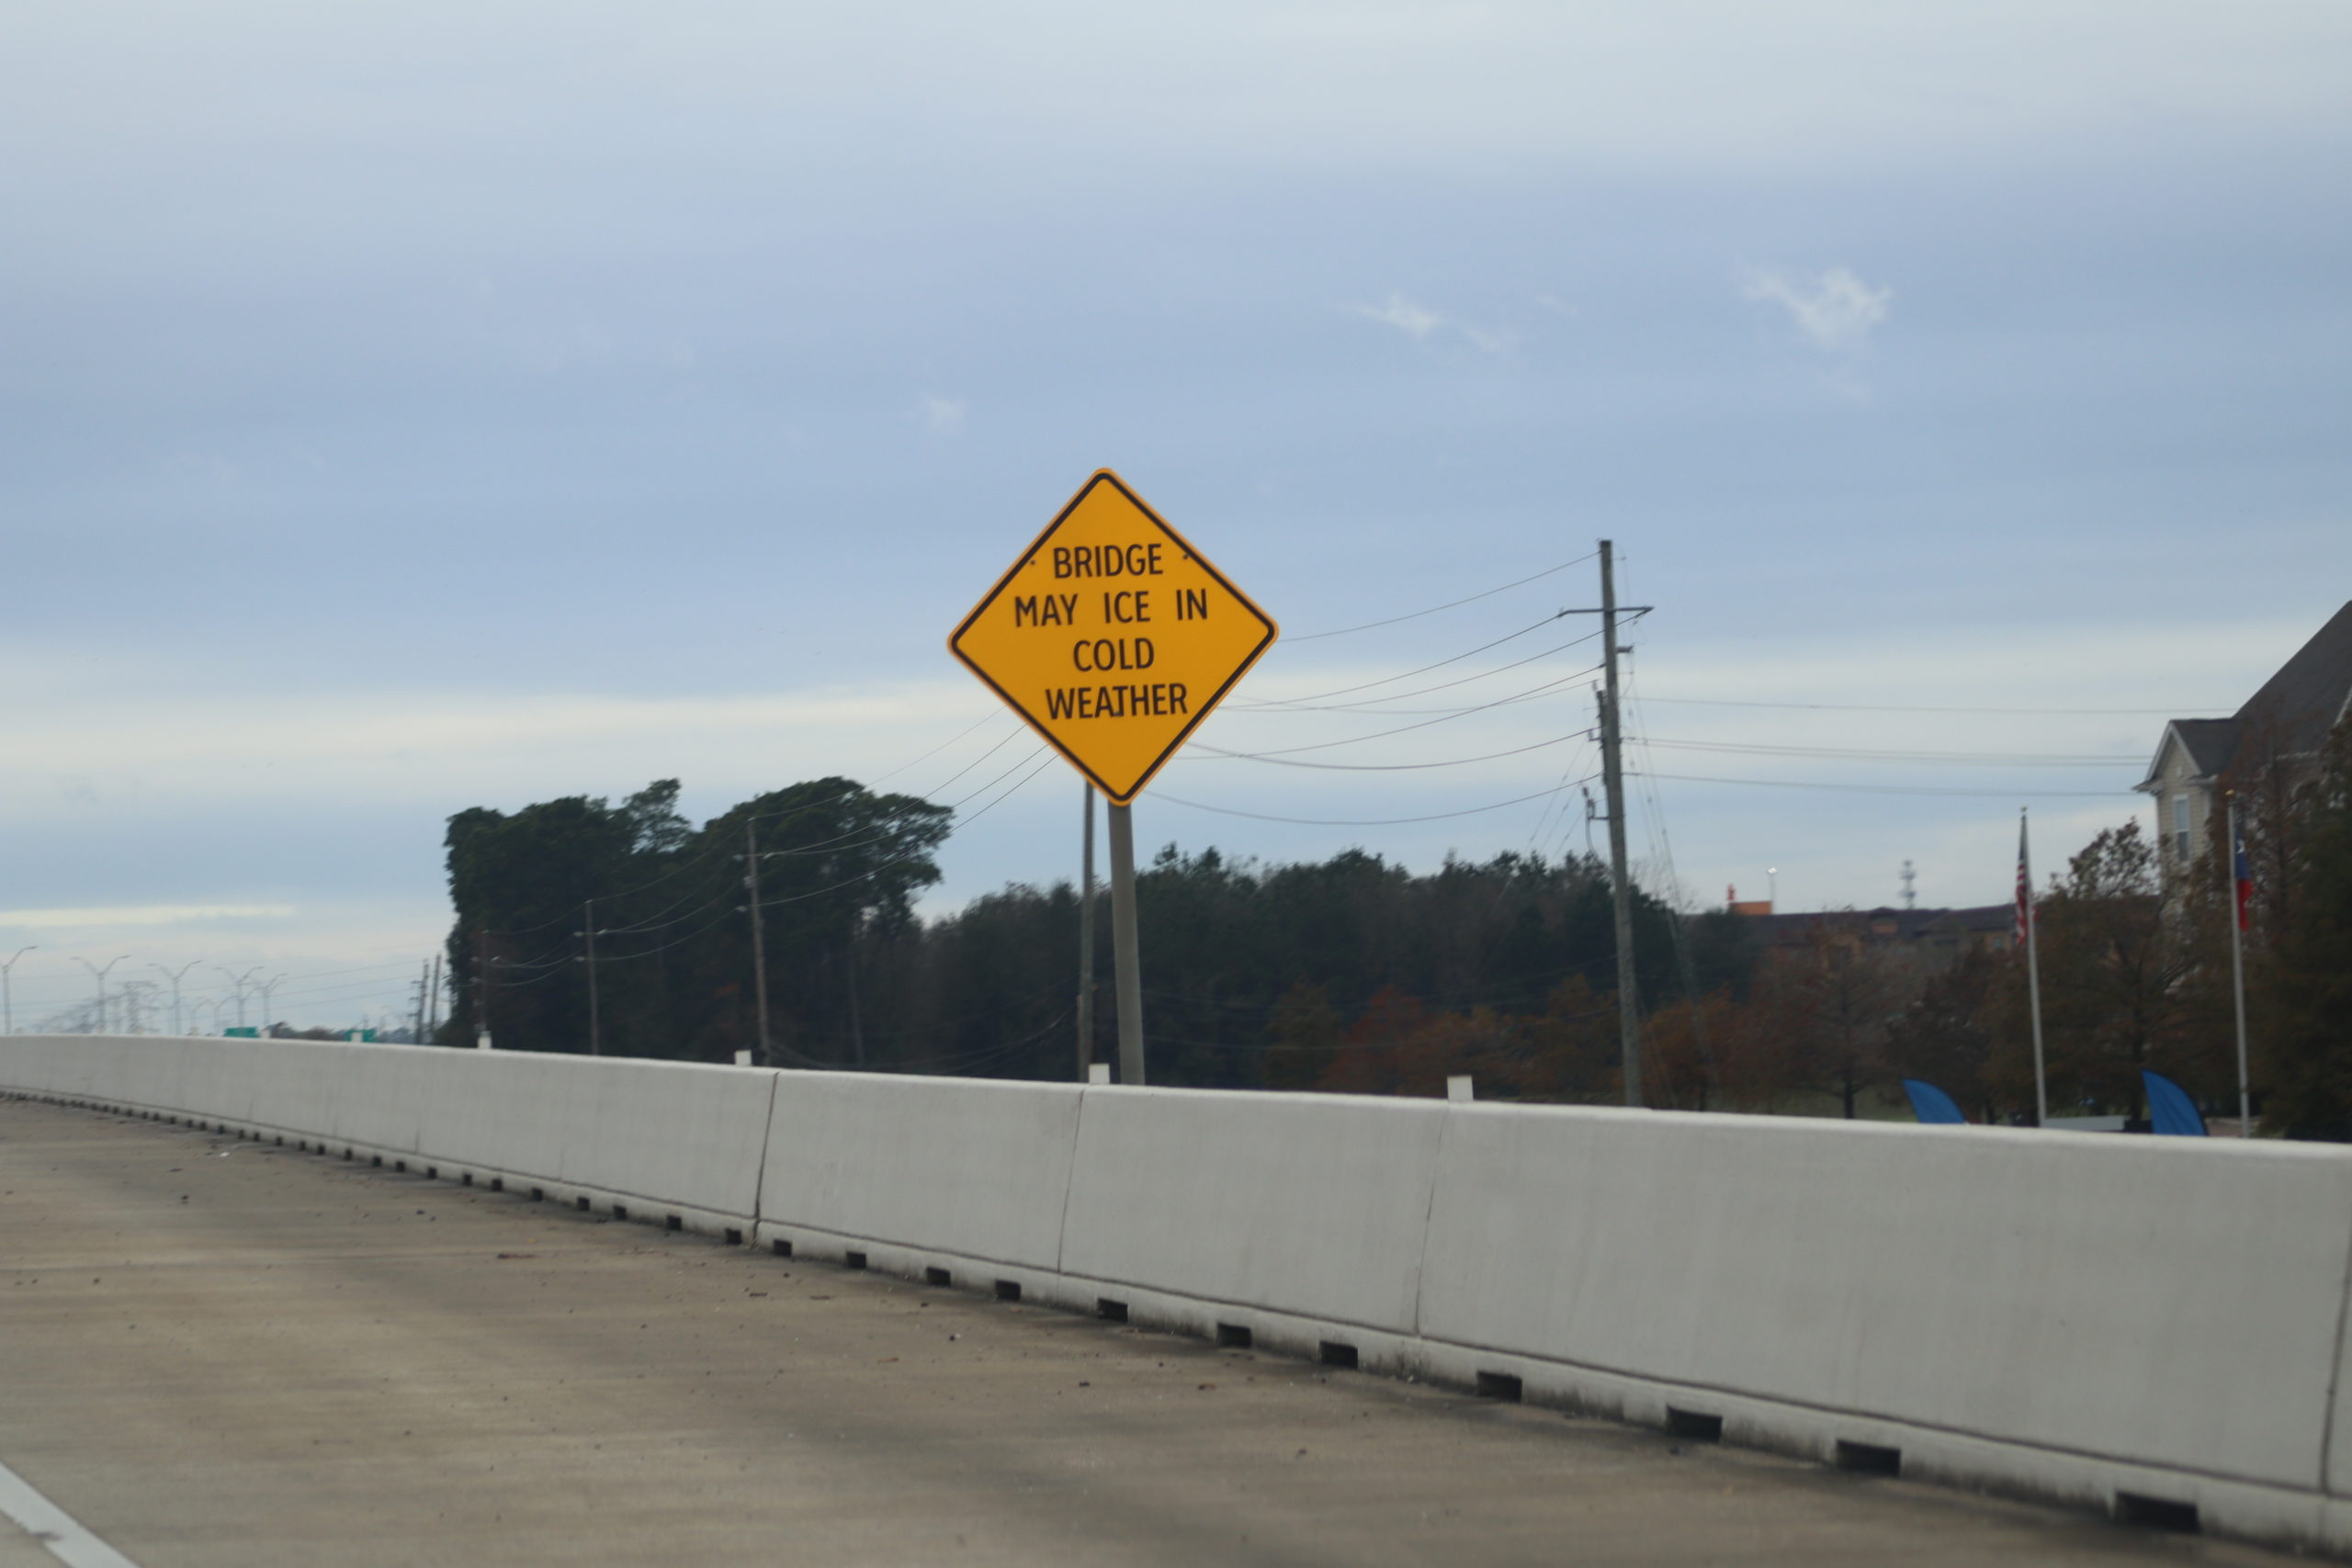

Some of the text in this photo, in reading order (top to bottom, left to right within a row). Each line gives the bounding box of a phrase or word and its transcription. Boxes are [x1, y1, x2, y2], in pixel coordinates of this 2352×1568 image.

[1053, 543, 1164, 580] BRIDGE
[1013, 588, 1209, 628] MAY ICE IN
[1072, 637, 1156, 672] COLD
[1045, 682, 1189, 720] WEATHER
